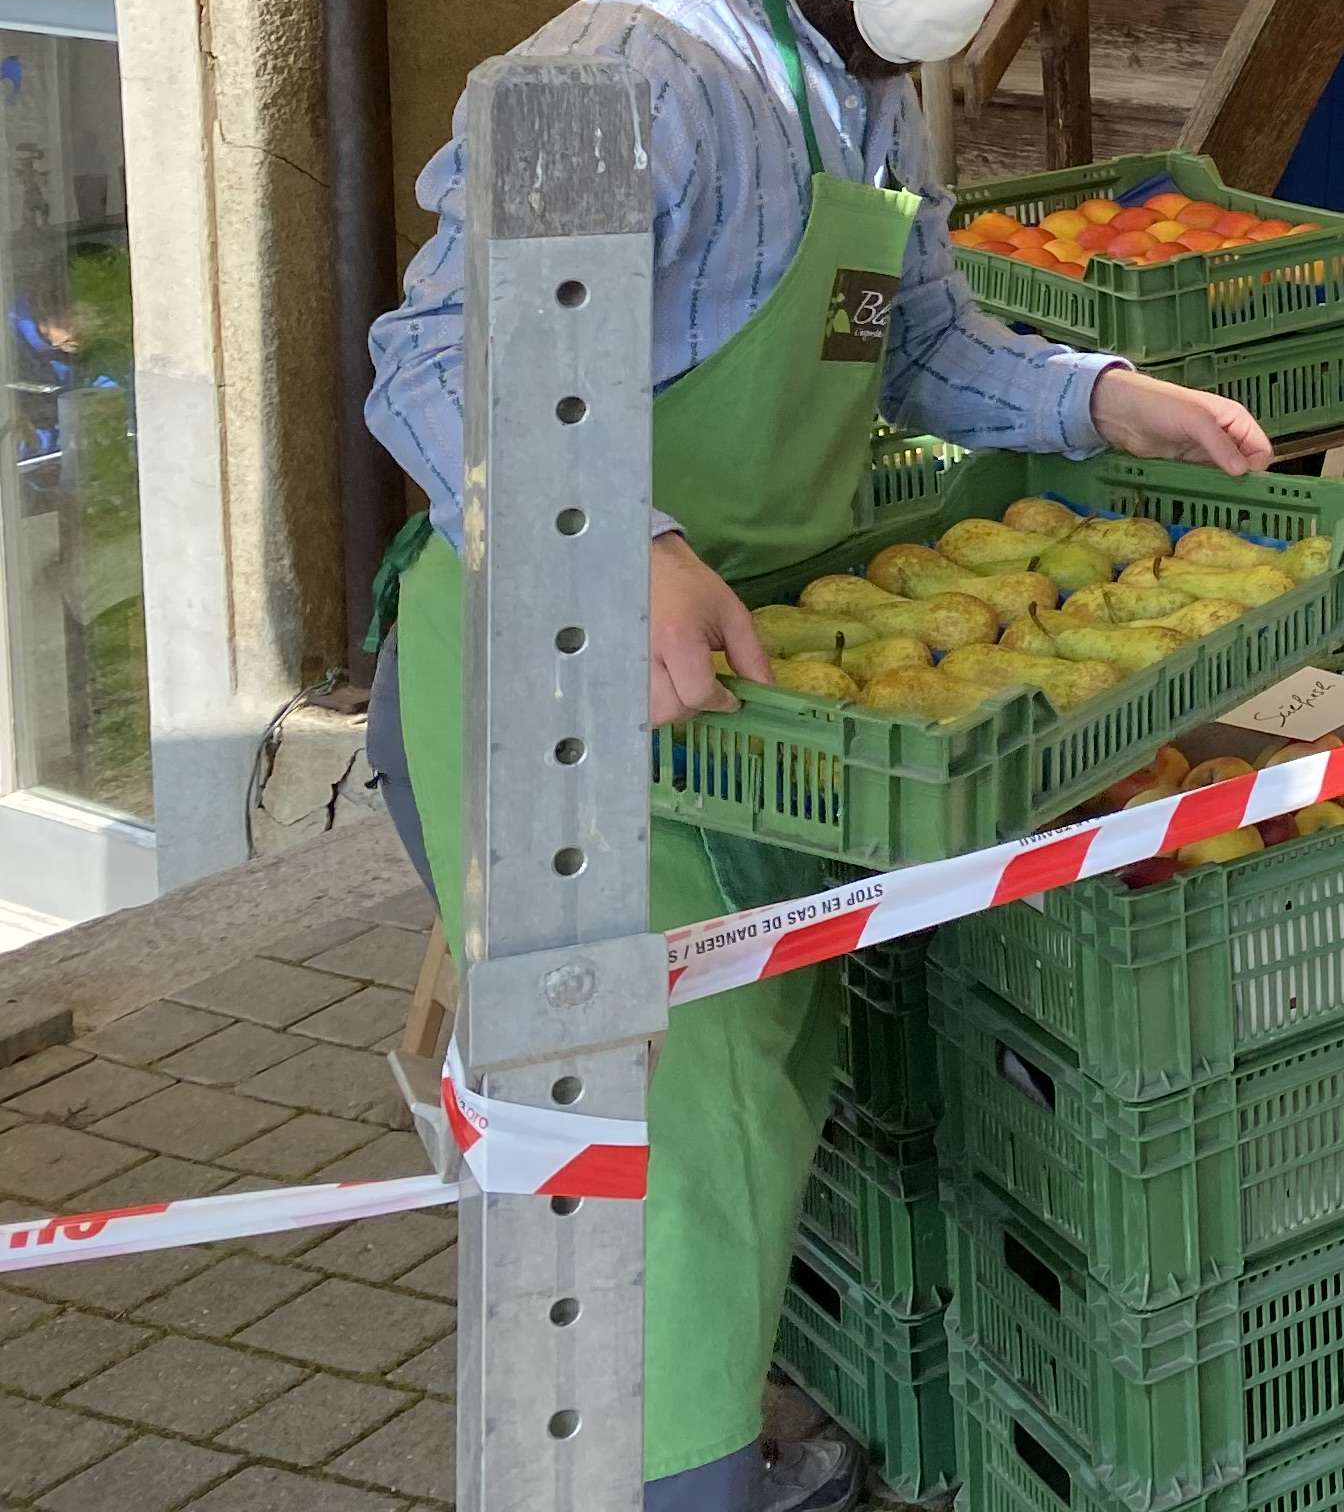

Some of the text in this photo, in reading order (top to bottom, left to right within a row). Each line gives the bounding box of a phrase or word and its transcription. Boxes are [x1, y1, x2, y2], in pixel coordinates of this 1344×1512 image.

[846, 882, 884, 907] STOP
[787, 905, 817, 926] CAS
[821, 896, 841, 916] EN
[762, 915, 782, 934] DE
[695, 923, 758, 955] DANGER
